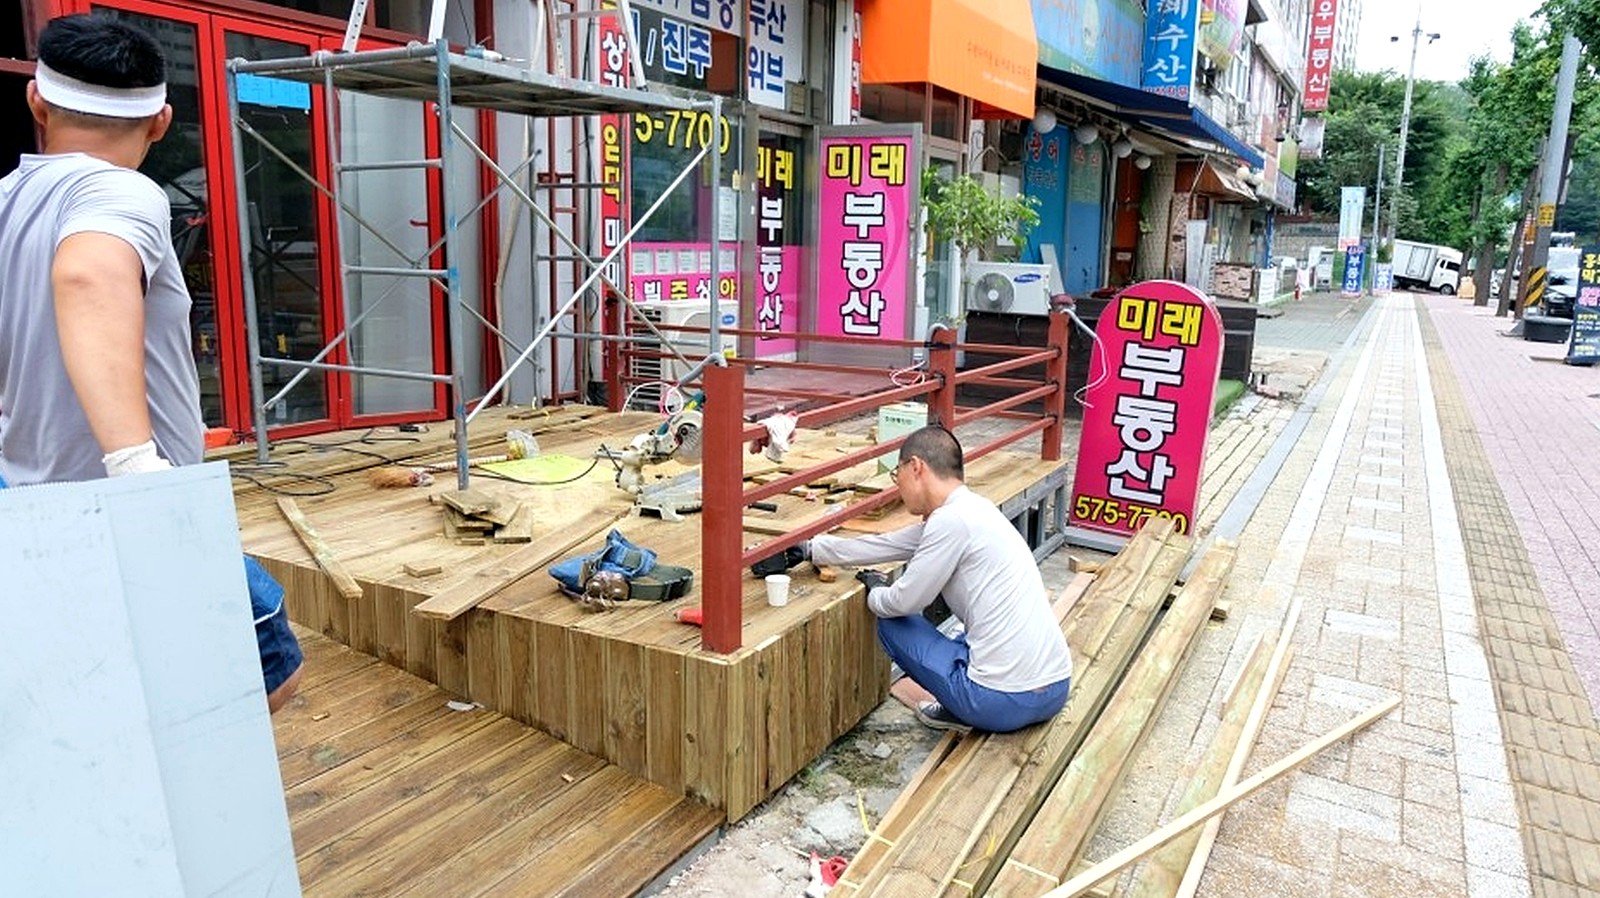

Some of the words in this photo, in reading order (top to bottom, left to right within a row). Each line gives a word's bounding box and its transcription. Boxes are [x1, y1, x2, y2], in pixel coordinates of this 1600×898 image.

[748, 46, 784, 94] 위브
[757, 146, 794, 190] 미래
[827, 143, 907, 186] 미래
[759, 195, 784, 340] 부동산
[840, 191, 886, 336] 부동산
[1117, 295, 1204, 347] 미래
[1106, 341, 1184, 506] 부동산
[1074, 493, 1188, 535] 575-70
